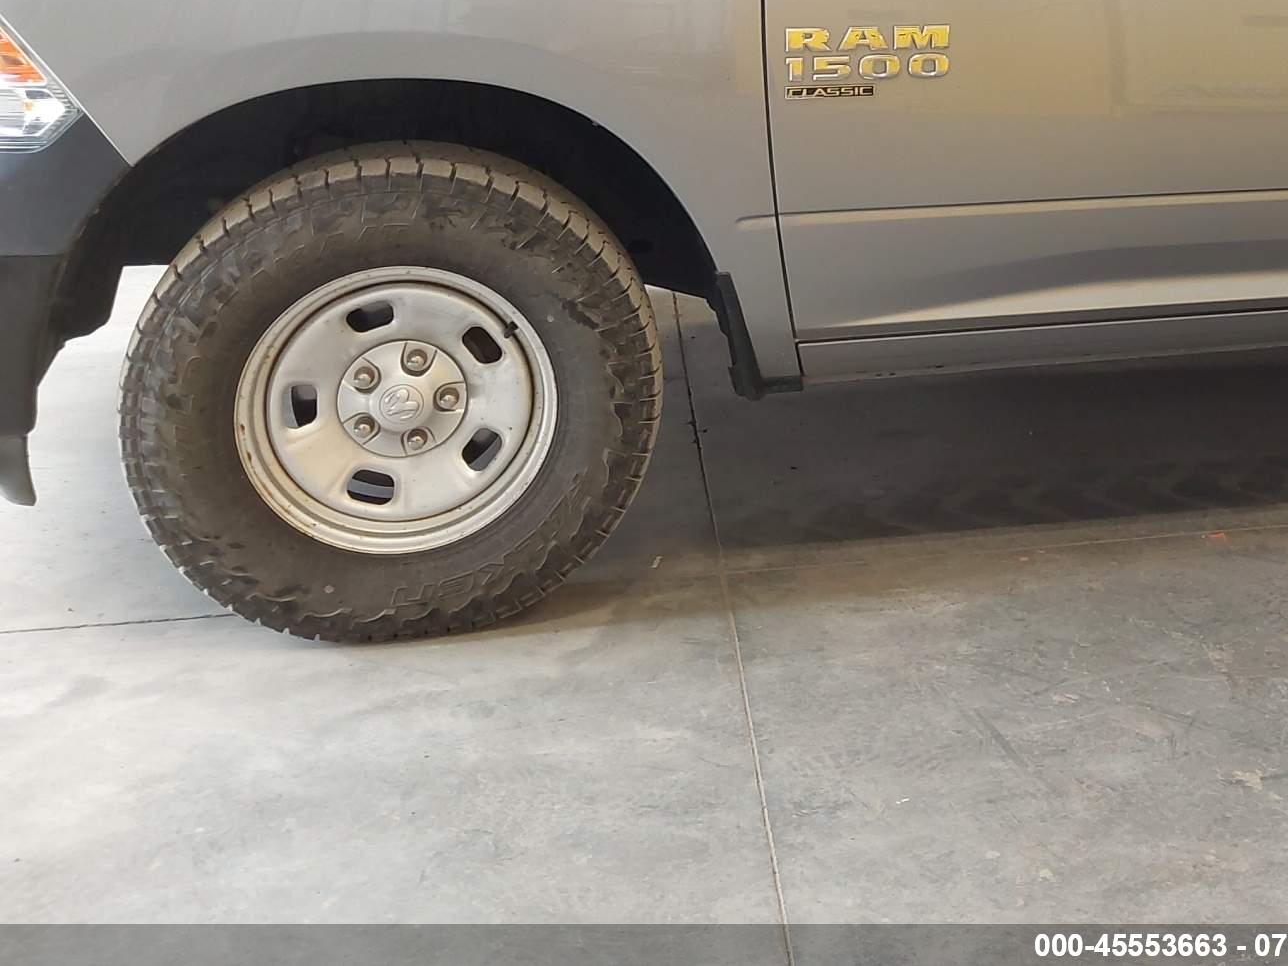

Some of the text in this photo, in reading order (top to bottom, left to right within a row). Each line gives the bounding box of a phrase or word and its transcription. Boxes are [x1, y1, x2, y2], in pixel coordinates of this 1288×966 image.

[785, 24, 951, 52] RAM
[785, 53, 950, 81] 1500
[786, 85, 873, 98] CLASSIC
